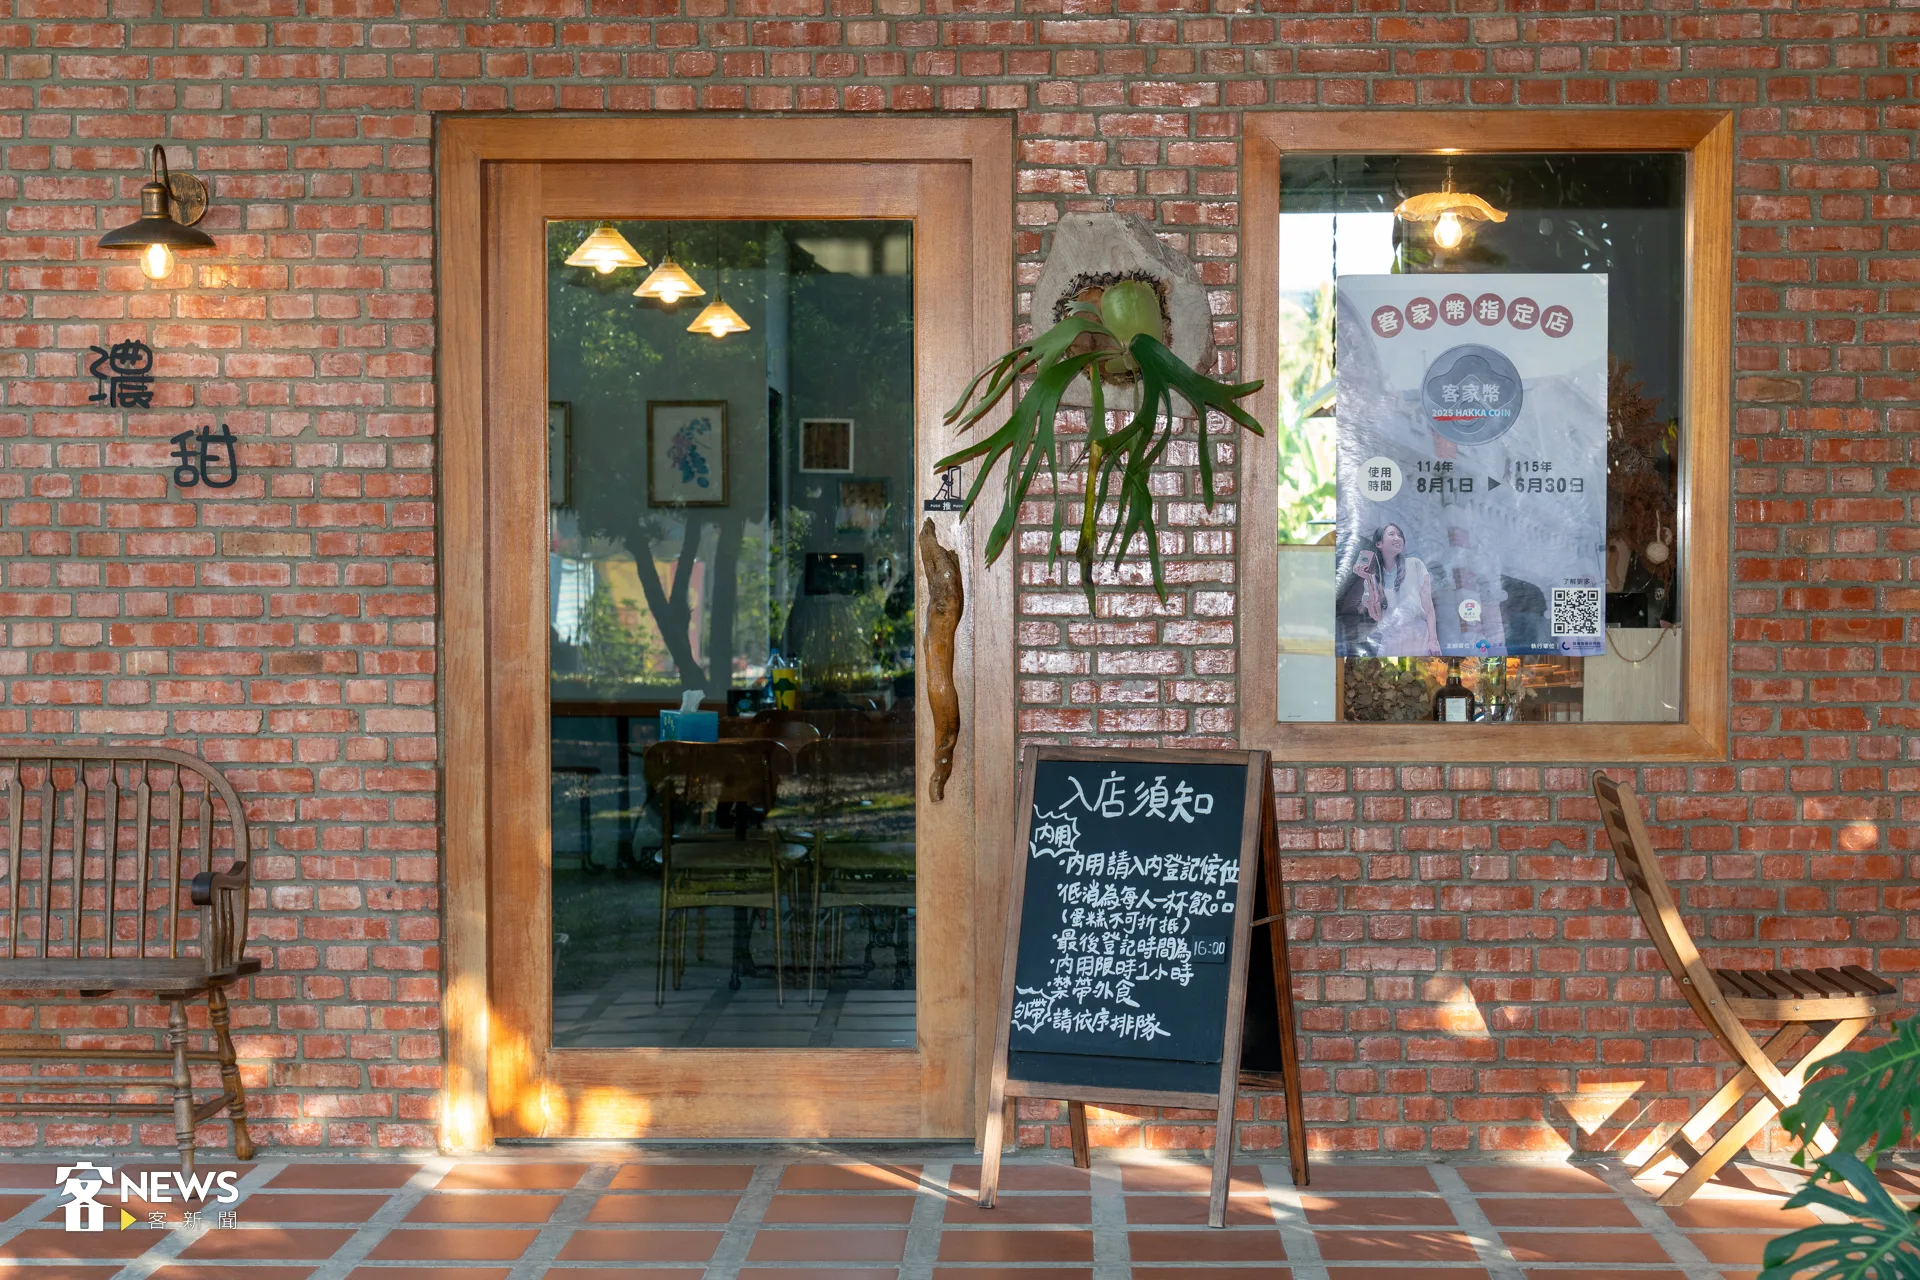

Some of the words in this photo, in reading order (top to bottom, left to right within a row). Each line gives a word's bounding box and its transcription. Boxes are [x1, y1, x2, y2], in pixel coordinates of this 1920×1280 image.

[1376, 299, 1569, 333] 客家幣指定店
[88, 338, 155, 409] 濃
[1441, 383, 1501, 403] 客家幣
[1431, 408, 1454, 418] 2025
[1455, 408, 1487, 417] HAKKA
[1488, 408, 1511, 417] COIN
[170, 424, 238, 488] 甜
[1367, 466, 1392, 478] 使用
[1416, 460, 1454, 473] 114年
[1515, 460, 1553, 473] 115年
[1367, 480, 1392, 492] 時間
[1416, 477, 1474, 493] 8月1日
[1515, 477, 1584, 493] 6月30日
[1058, 770, 1214, 824] 入店須知
[1034, 822, 1072, 848] 內用
[1193, 941, 1225, 956] 16:00
[1050, 975, 1141, 1008] 禁帶外食
[1052, 1007, 1172, 1041] 請依序排隊
